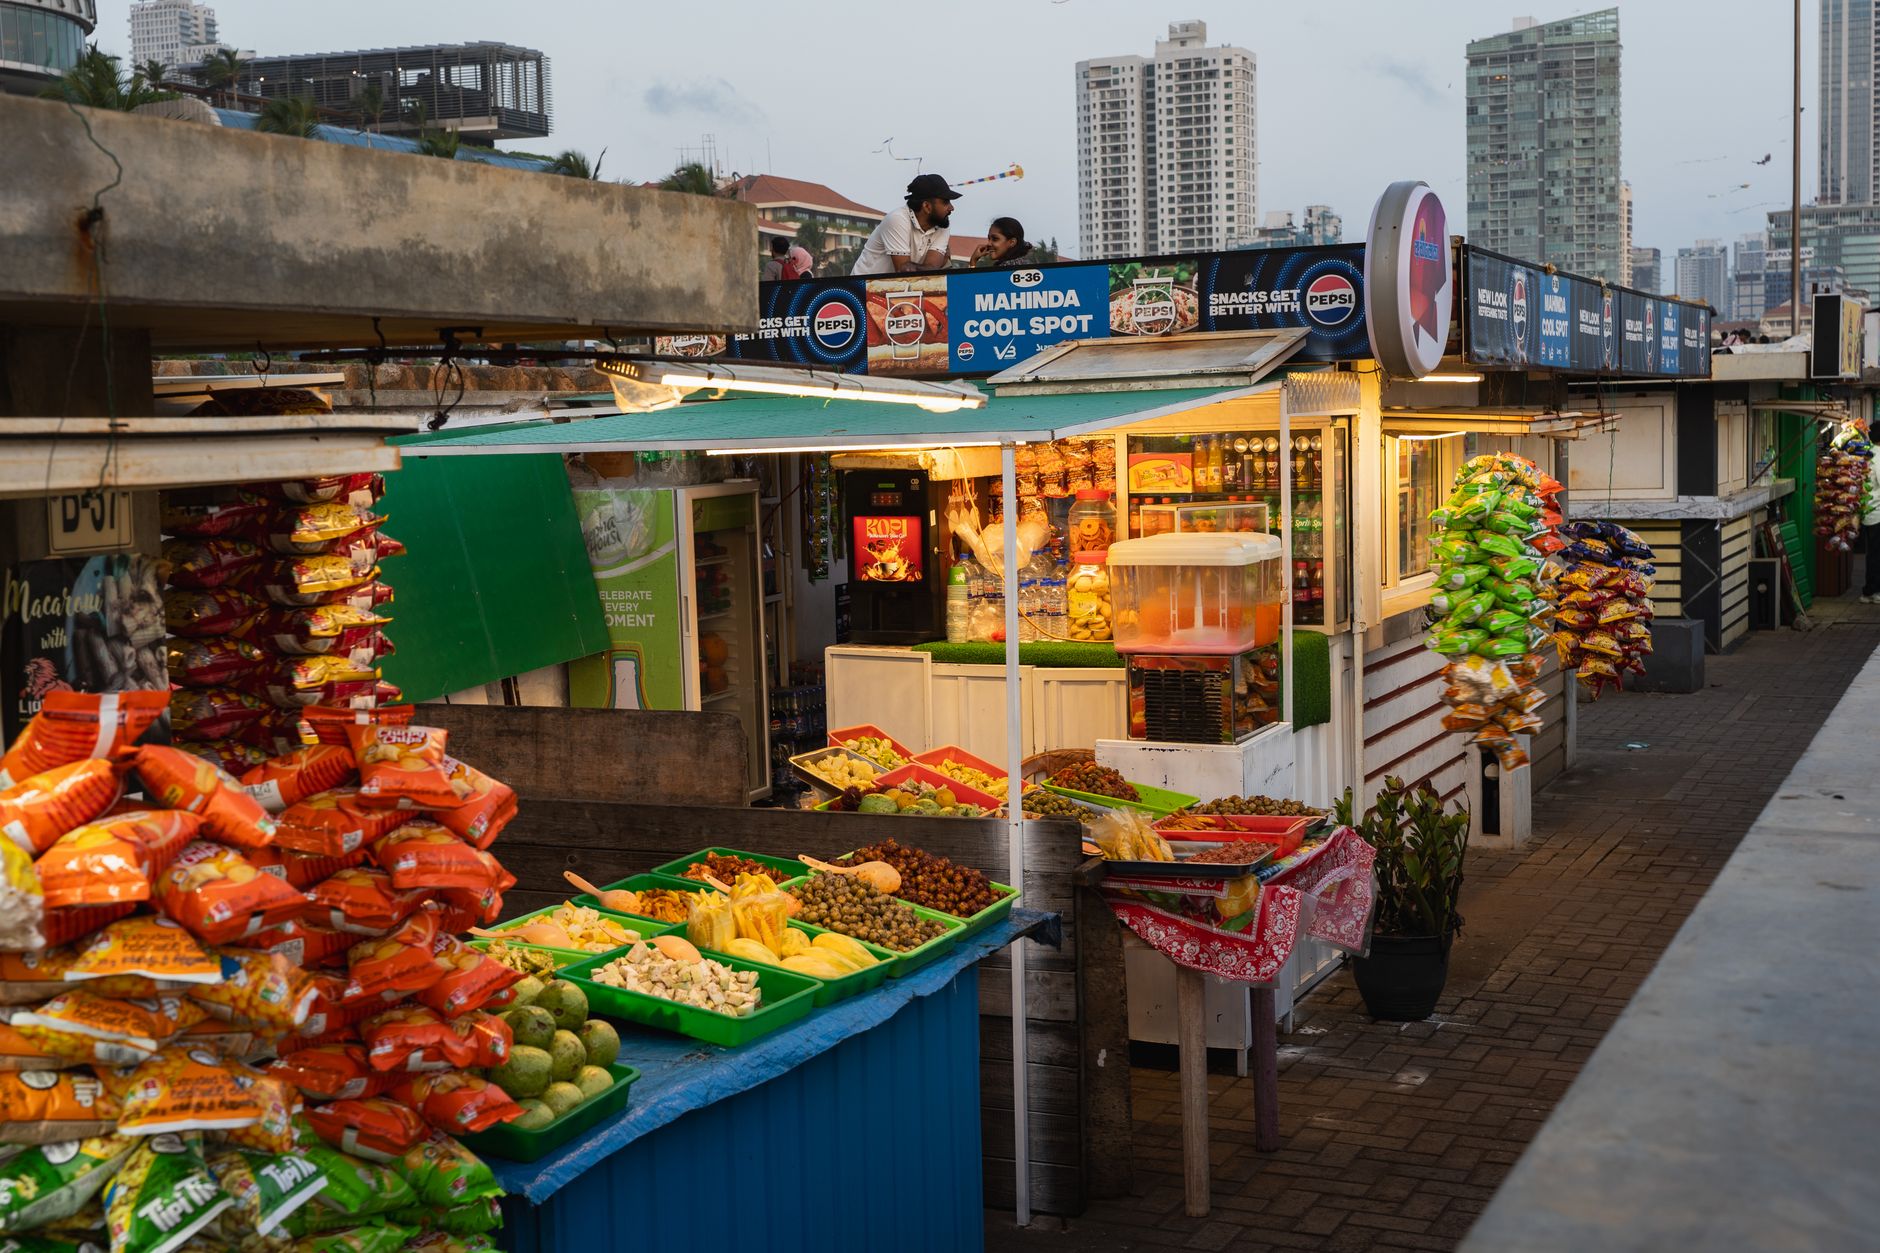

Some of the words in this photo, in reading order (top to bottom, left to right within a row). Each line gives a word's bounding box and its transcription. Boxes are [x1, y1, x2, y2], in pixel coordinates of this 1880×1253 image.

[1012, 272, 1041, 283] B-36
[974, 289, 1081, 312] MAHINDA
[1209, 291, 1266, 305] SNACKS
[1267, 289, 1300, 302] GET
[1309, 294, 1353, 306] PEPSI
[1478, 288, 1491, 304] NEW
[1492, 291, 1508, 308] LOOK
[1135, 305, 1173, 317] PEPSI
[1209, 304, 1264, 316] BETTER
[1265, 303, 1301, 314] WITH
[1514, 304, 1526, 317] PEPSI
[759, 317, 783, 328] CKS
[785, 316, 811, 327] GET
[816, 319, 855, 331] PEPSI
[887, 319, 923, 329] PEPSI
[963, 318, 1026, 338] COOL
[1029, 314, 1094, 335] SPOT
[1541, 318, 1555, 336] COOL
[1556, 320, 1568, 337] SPOT
[781, 327, 811, 338] WITH
[866, 518, 908, 537] KOPI
[599, 591, 652, 600] ELEBRATE
[605, 602, 639, 612] EVERY
[605, 614, 655, 627] OMENT
[40, 627, 68, 650] with
